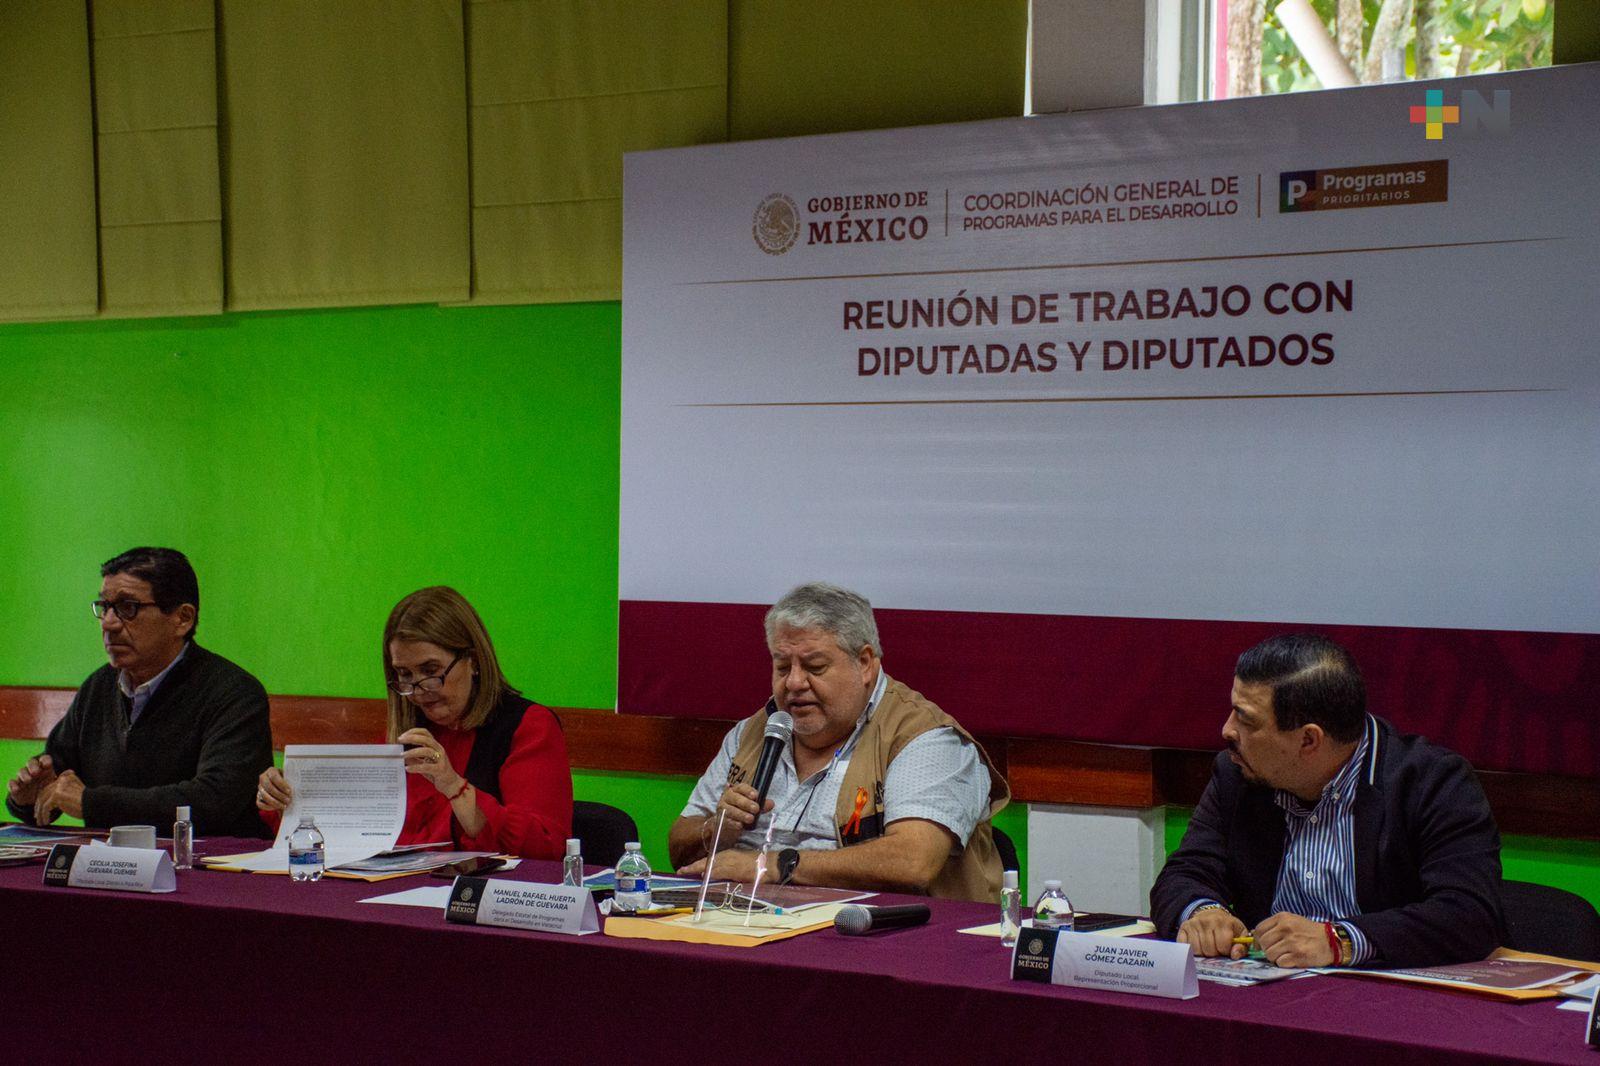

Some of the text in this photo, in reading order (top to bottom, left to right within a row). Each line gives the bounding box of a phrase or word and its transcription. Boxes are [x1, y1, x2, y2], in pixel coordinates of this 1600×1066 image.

[1323, 170, 1427, 192] Programas
[964, 176, 1240, 212] COORDINACIÓN GENERAL DE
[1287, 180, 1308, 207] P
[1322, 190, 1411, 205] PRIORITARIOS
[807, 191, 928, 213] GOBIERNO DE
[963, 199, 1239, 232] PROGRAMAS PARA EL DESARROLLO
[807, 212, 928, 245] MÉXICO
[843, 279, 1354, 330] REUNIÓN DE TRABAJO CON
[857, 332, 1336, 377] DIPUTADAS Y DIPUTADOS
[493, 889, 576, 903] MANUEL RAFAEL HUERTA
[496, 896, 524, 906] LADRÓN
[536, 901, 569, 910] GUEVARA
[450, 906, 476, 914] MÉXICO
[1094, 945, 1149, 958] JUAN JAVIER
[1018, 959, 1049, 969] MÉXICO
[1085, 952, 1155, 968] GÓMEZ CAZARÍN
[1094, 969, 1122, 978] Diputado
[1073, 975, 1159, 991] Representación Proporcional
